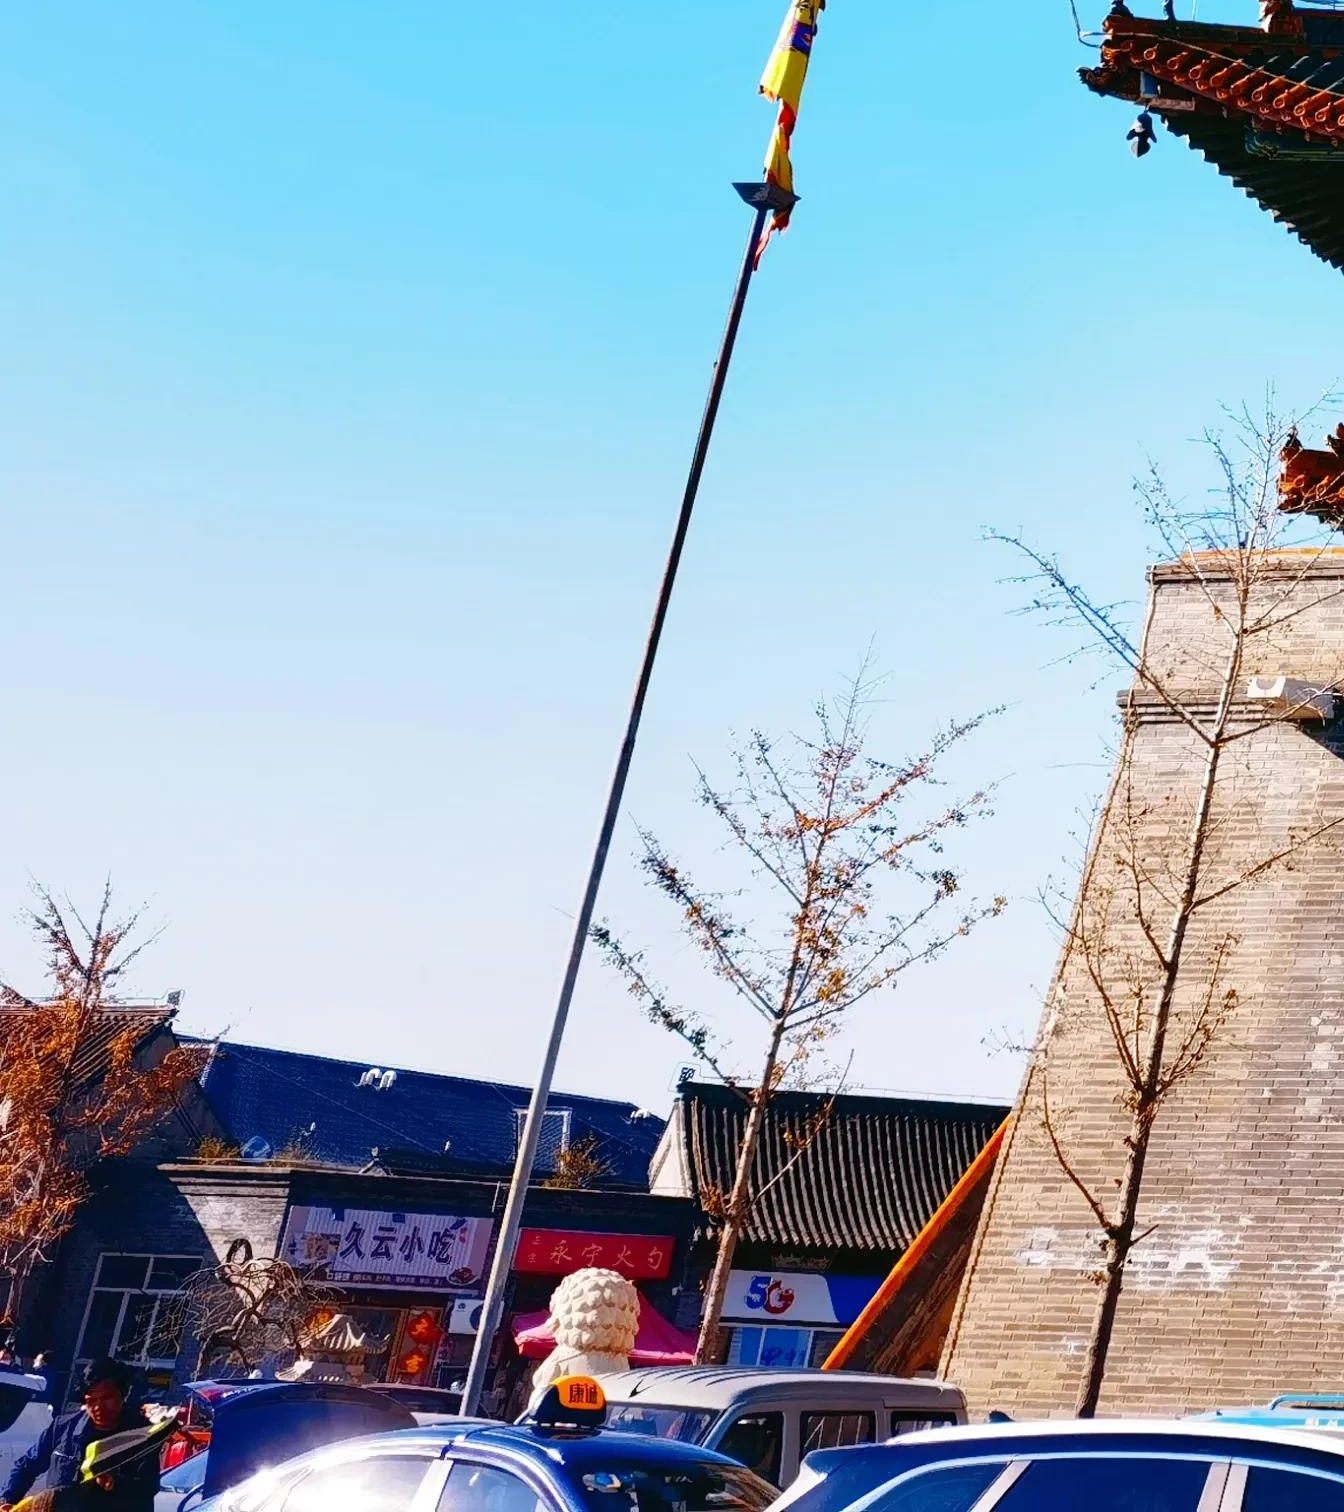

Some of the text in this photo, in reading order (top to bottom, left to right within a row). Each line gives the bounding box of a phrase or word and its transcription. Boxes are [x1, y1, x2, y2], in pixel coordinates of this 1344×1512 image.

[338, 1219, 462, 1266] 久云小吃
[549, 1239, 663, 1271] 永宁火勺
[744, 1274, 796, 1315] 5G
